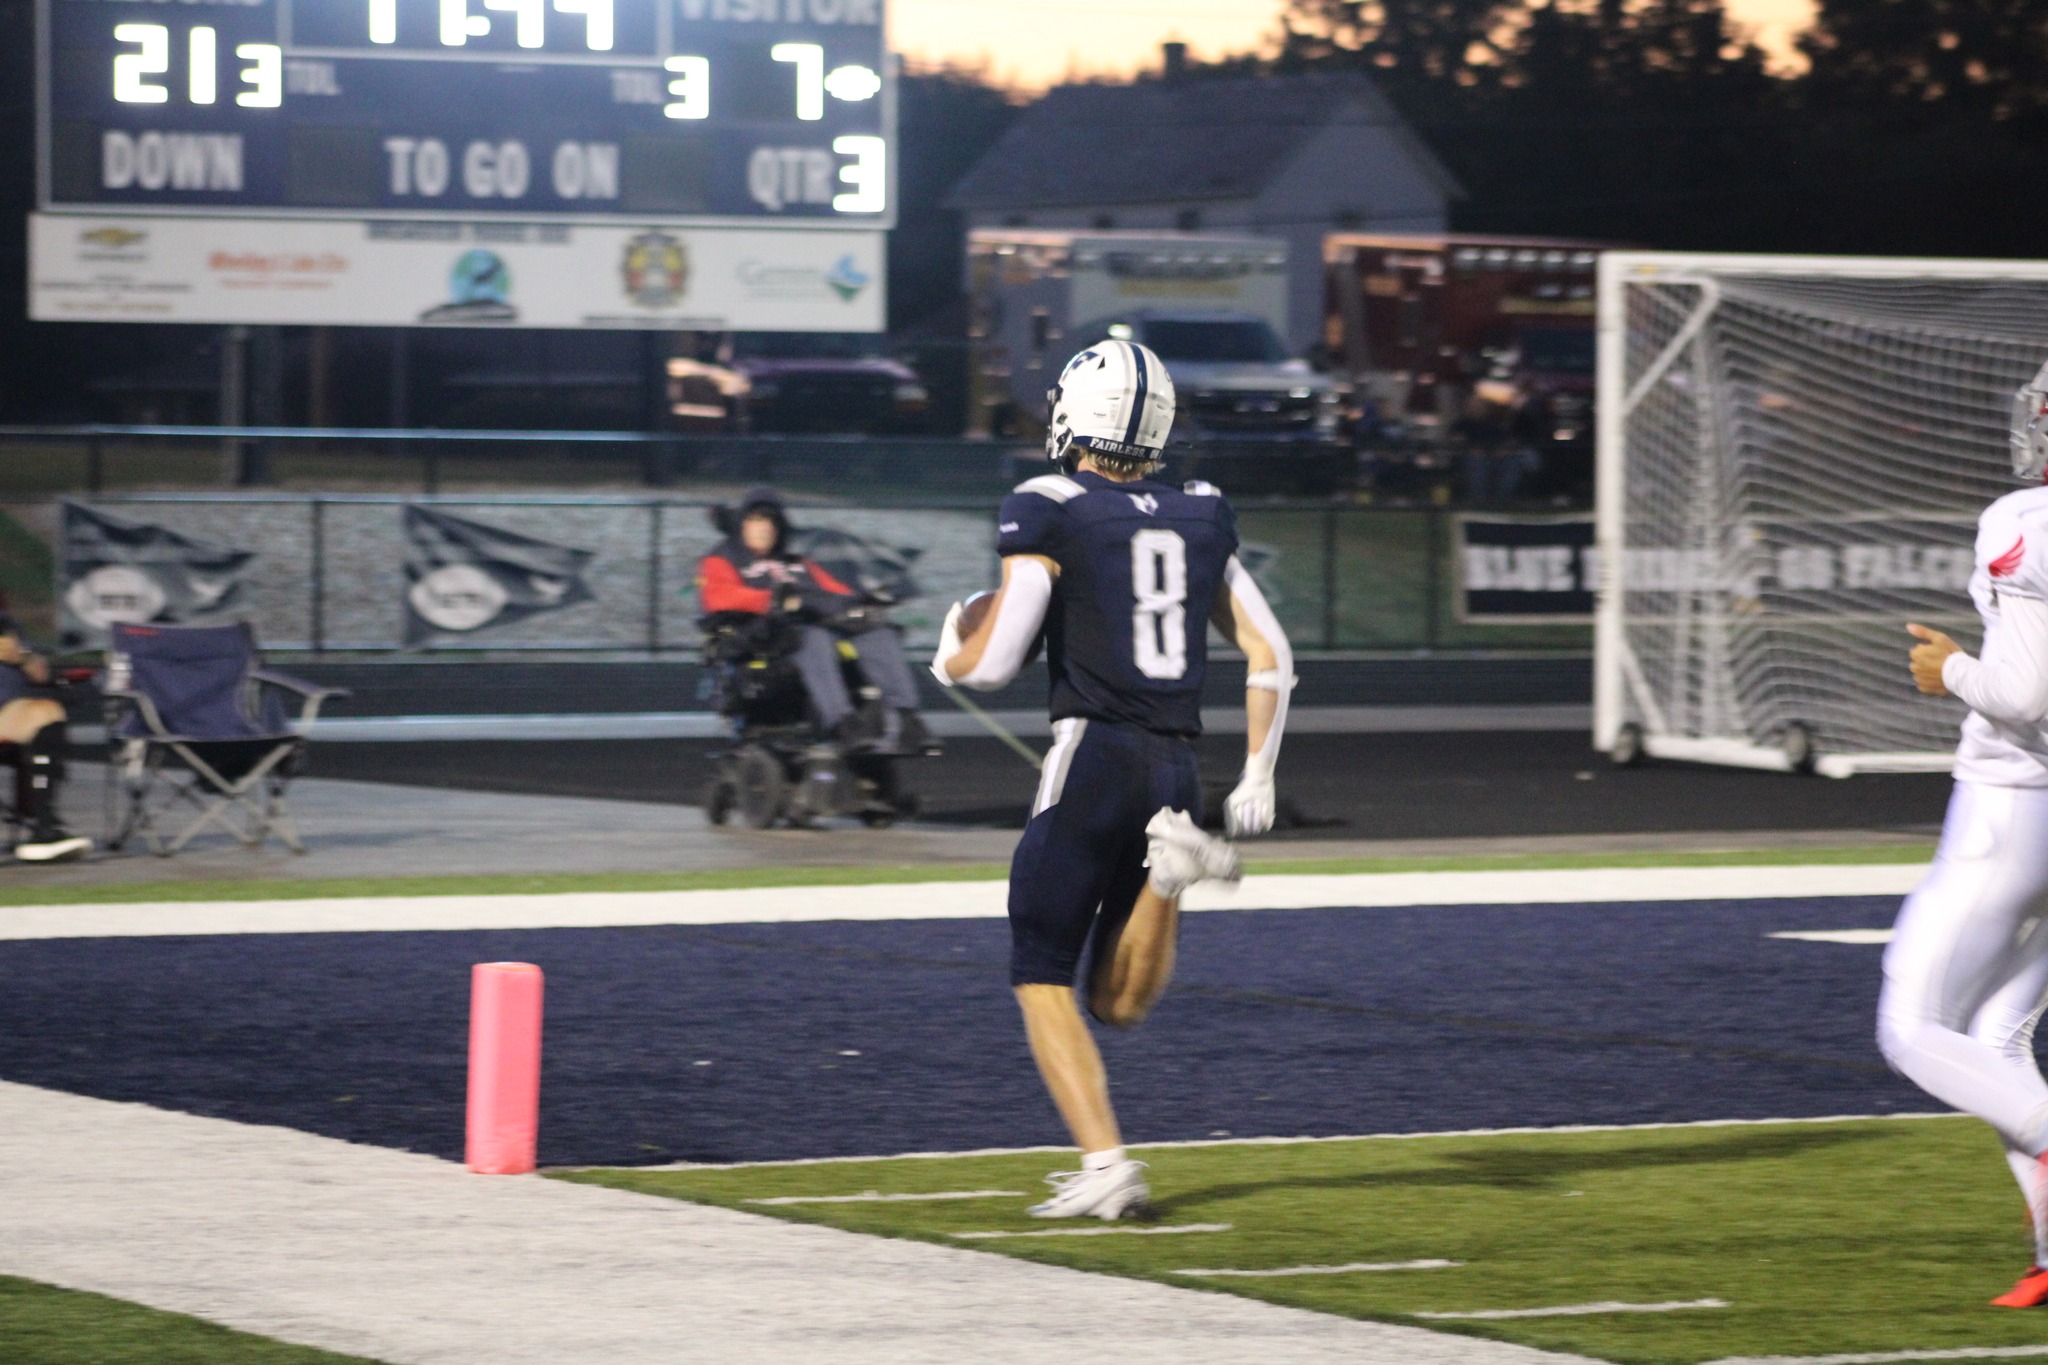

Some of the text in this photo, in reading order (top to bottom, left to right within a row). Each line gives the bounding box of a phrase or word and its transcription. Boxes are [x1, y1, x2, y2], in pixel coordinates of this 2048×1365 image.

[113, 24, 216, 105] 21
[236, 44, 282, 108] 3
[664, 56, 709, 119] 3
[771, 43, 824, 120] 7
[103, 131, 243, 191] DOWN
[385, 138, 619, 199] TO GO ON
[747, 147, 833, 210] QTR
[833, 135, 886, 213] 3
[1089, 437, 1146, 458] FAIRLESS
[1131, 528, 1187, 680] 8
